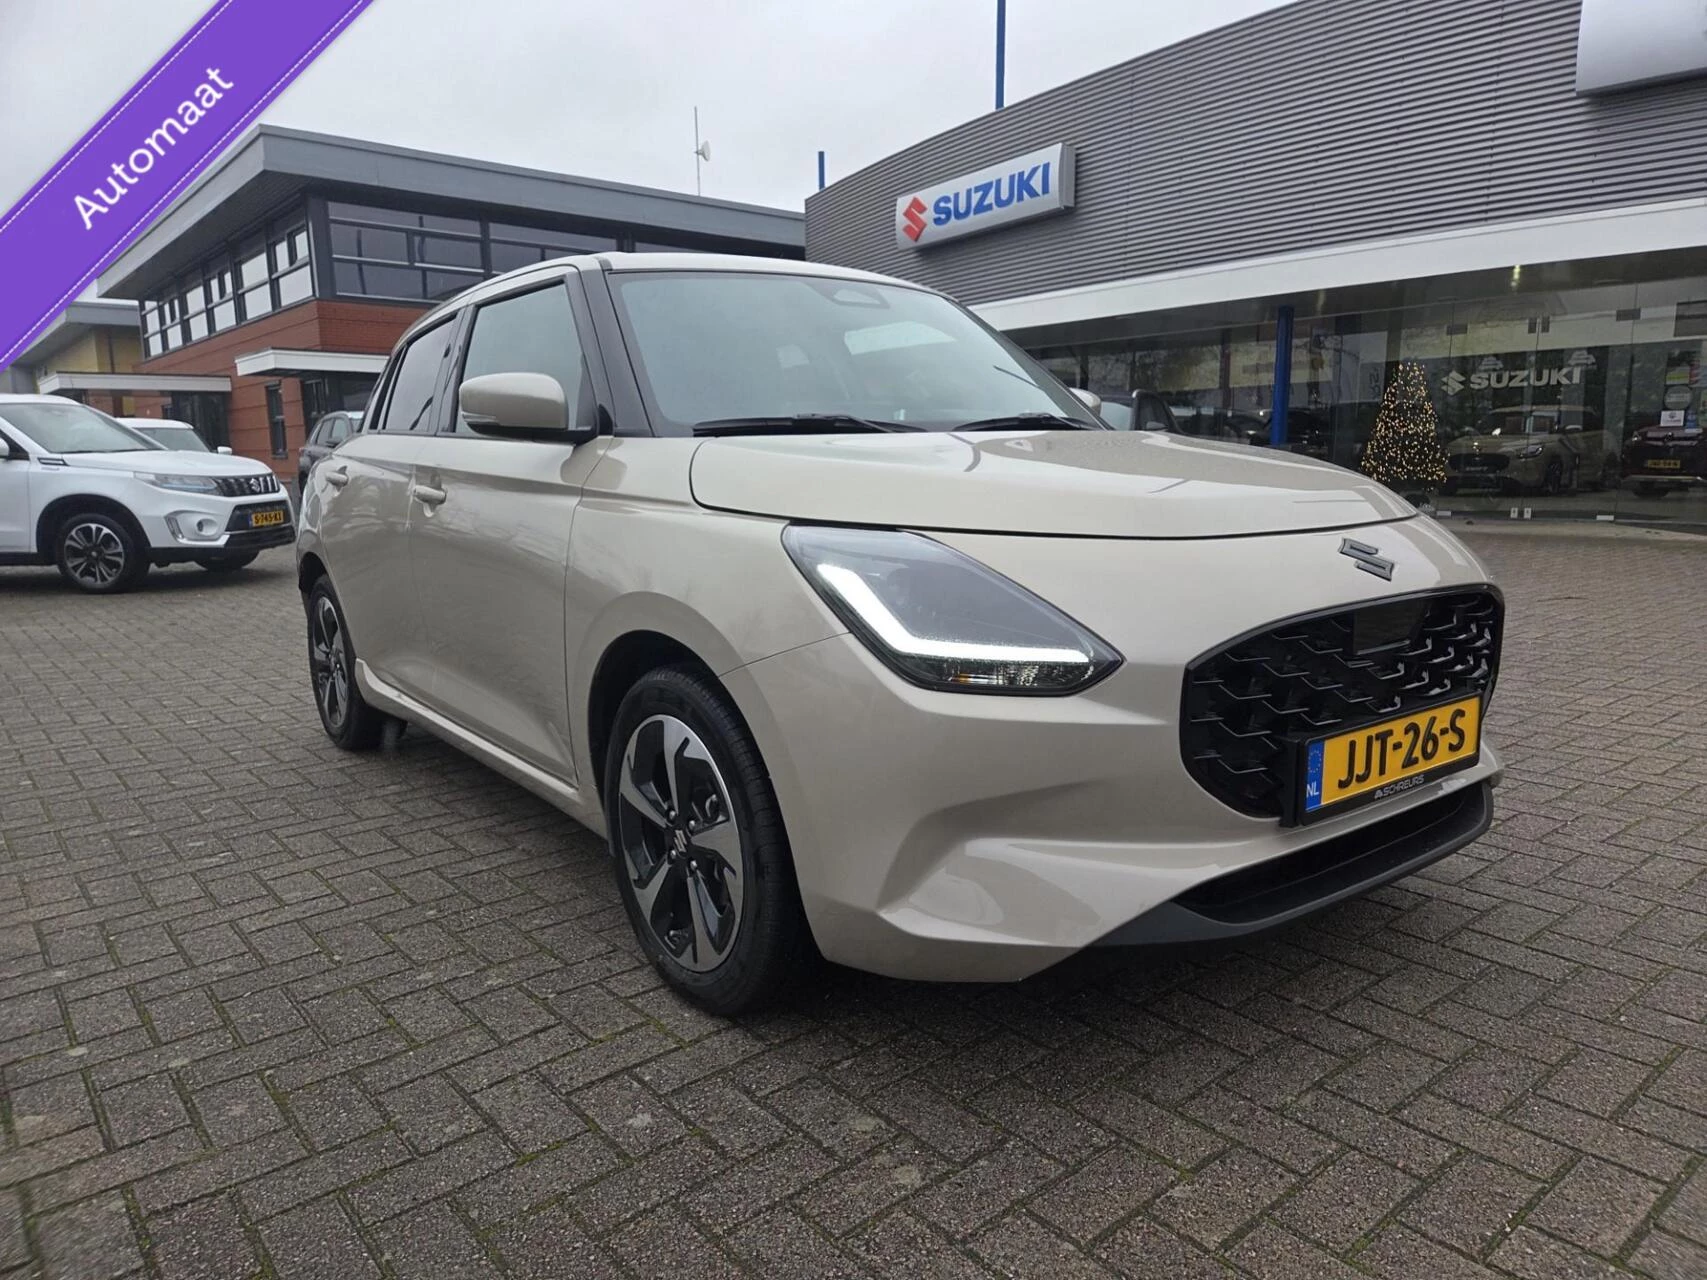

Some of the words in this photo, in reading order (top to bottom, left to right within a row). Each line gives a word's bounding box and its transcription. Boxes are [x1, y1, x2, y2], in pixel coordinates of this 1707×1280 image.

[932, 161, 1050, 227] SUZUKI
[1470, 367, 1582, 390] SUZUKI
[1337, 708, 1466, 790] JJT-26-S
[1305, 781, 1320, 798] NL
